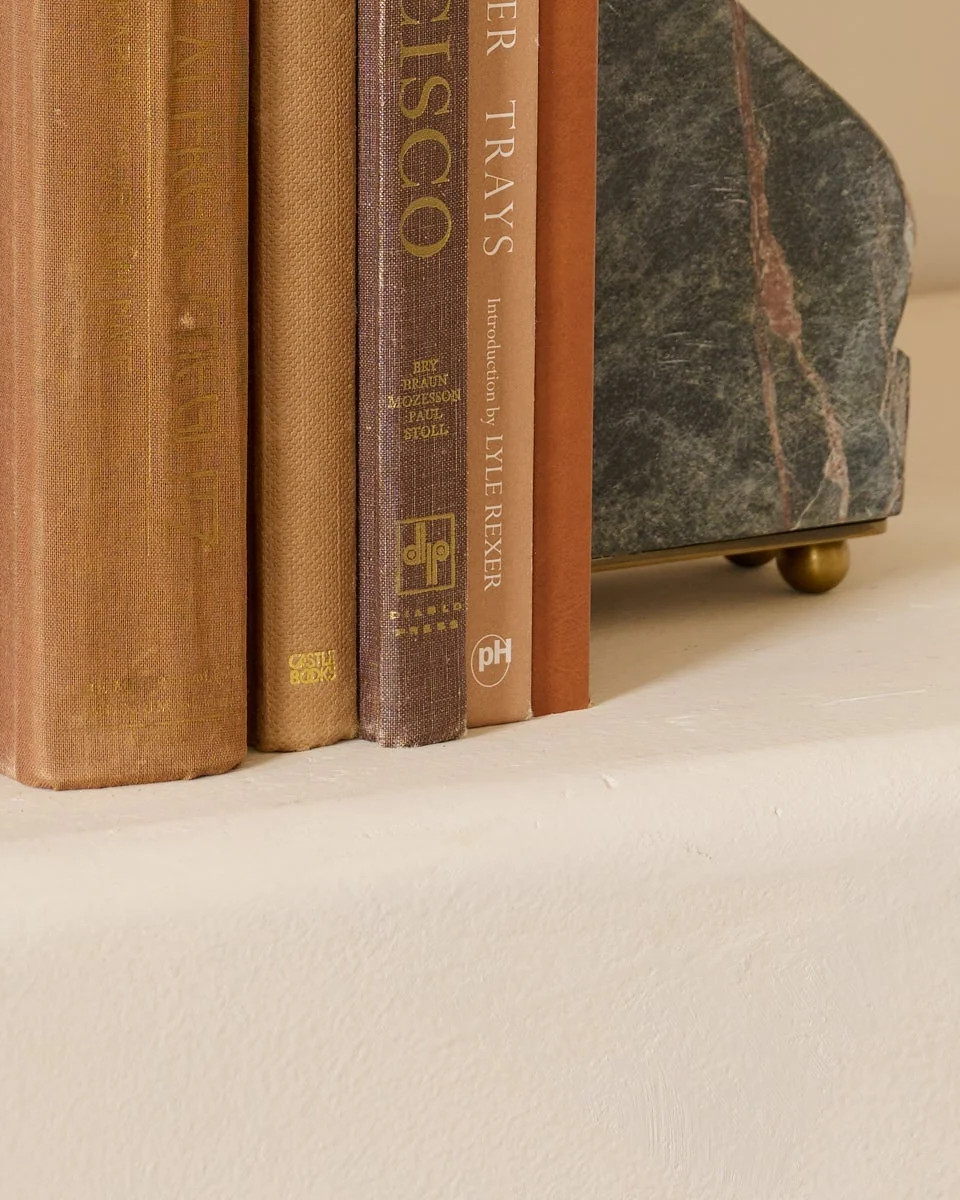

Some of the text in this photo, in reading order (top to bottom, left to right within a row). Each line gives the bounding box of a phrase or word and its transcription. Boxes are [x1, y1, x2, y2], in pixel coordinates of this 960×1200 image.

[483, 100, 516, 256] TRAYS
[402, 373, 448, 390] BRAUN
[409, 407, 444, 423] PAUL
[404, 423, 449, 440] STOLL
[480, 298, 503, 591] Introduction by LYLE REXER
[478, 638, 512, 672] pH
